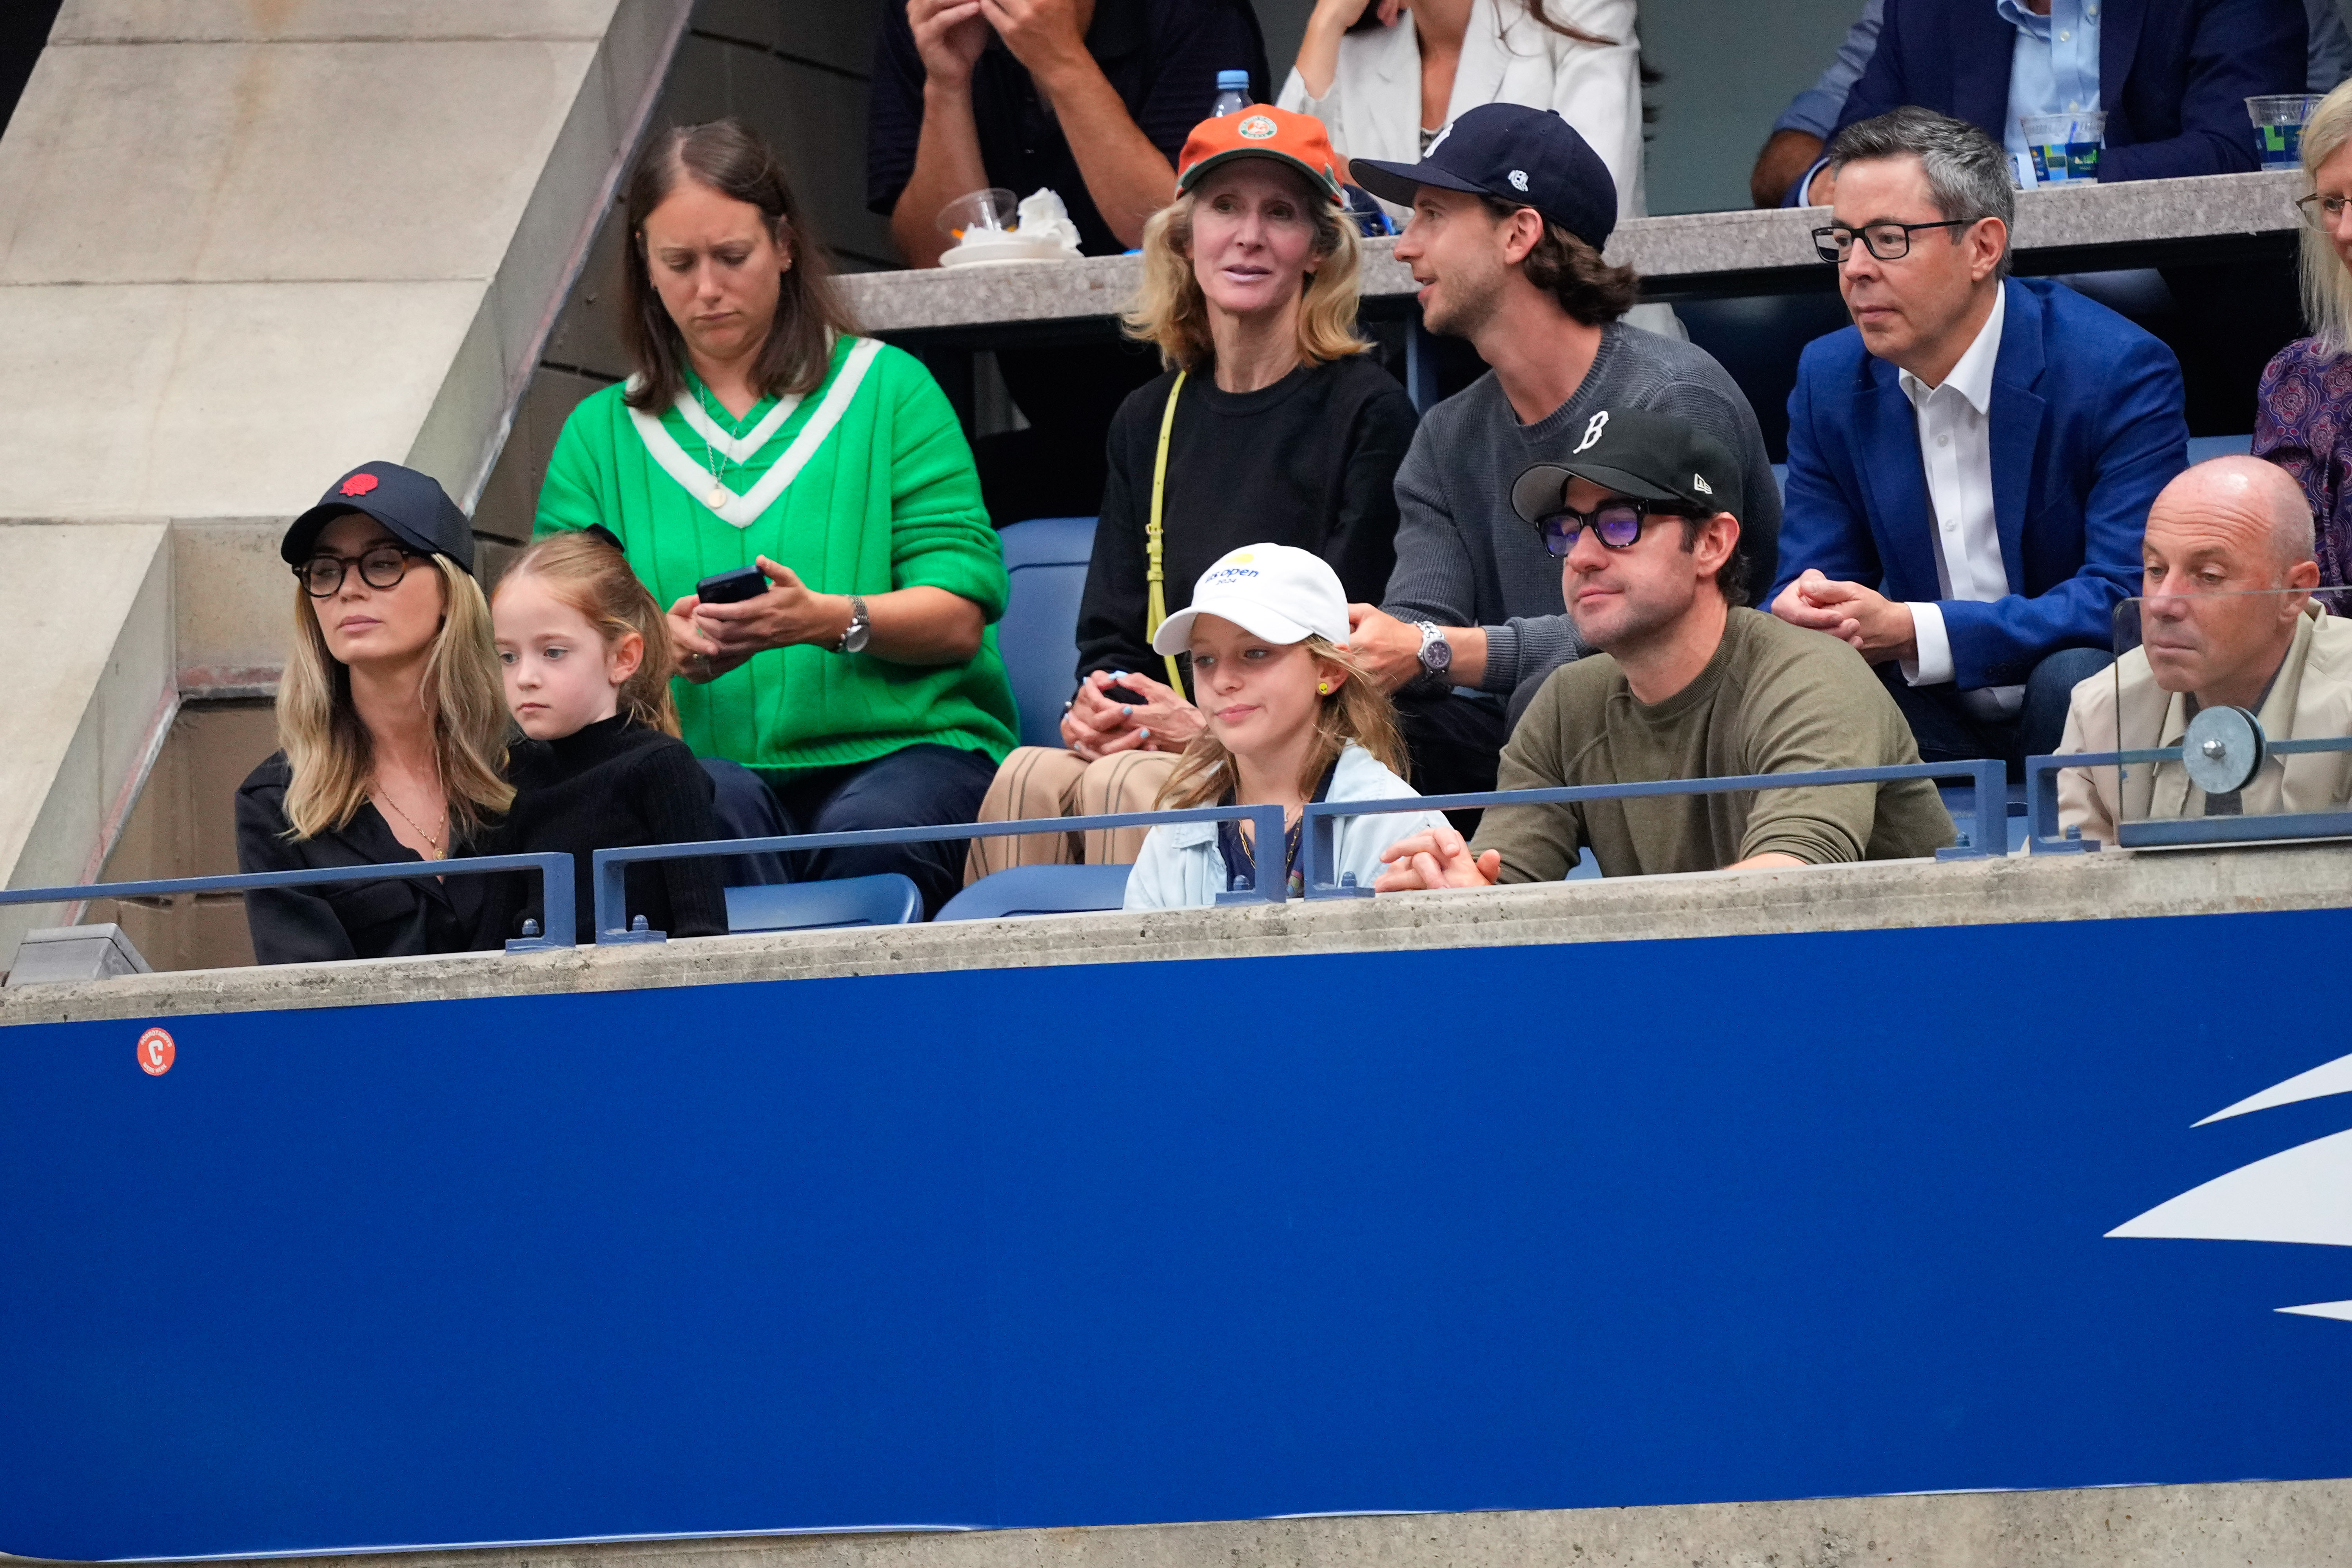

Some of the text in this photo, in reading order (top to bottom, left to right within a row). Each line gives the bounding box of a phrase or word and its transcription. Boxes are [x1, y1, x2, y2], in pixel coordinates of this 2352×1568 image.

[1573, 410, 1609, 454] B
[1220, 568, 1259, 577] open
[148, 1040, 163, 1066] C
